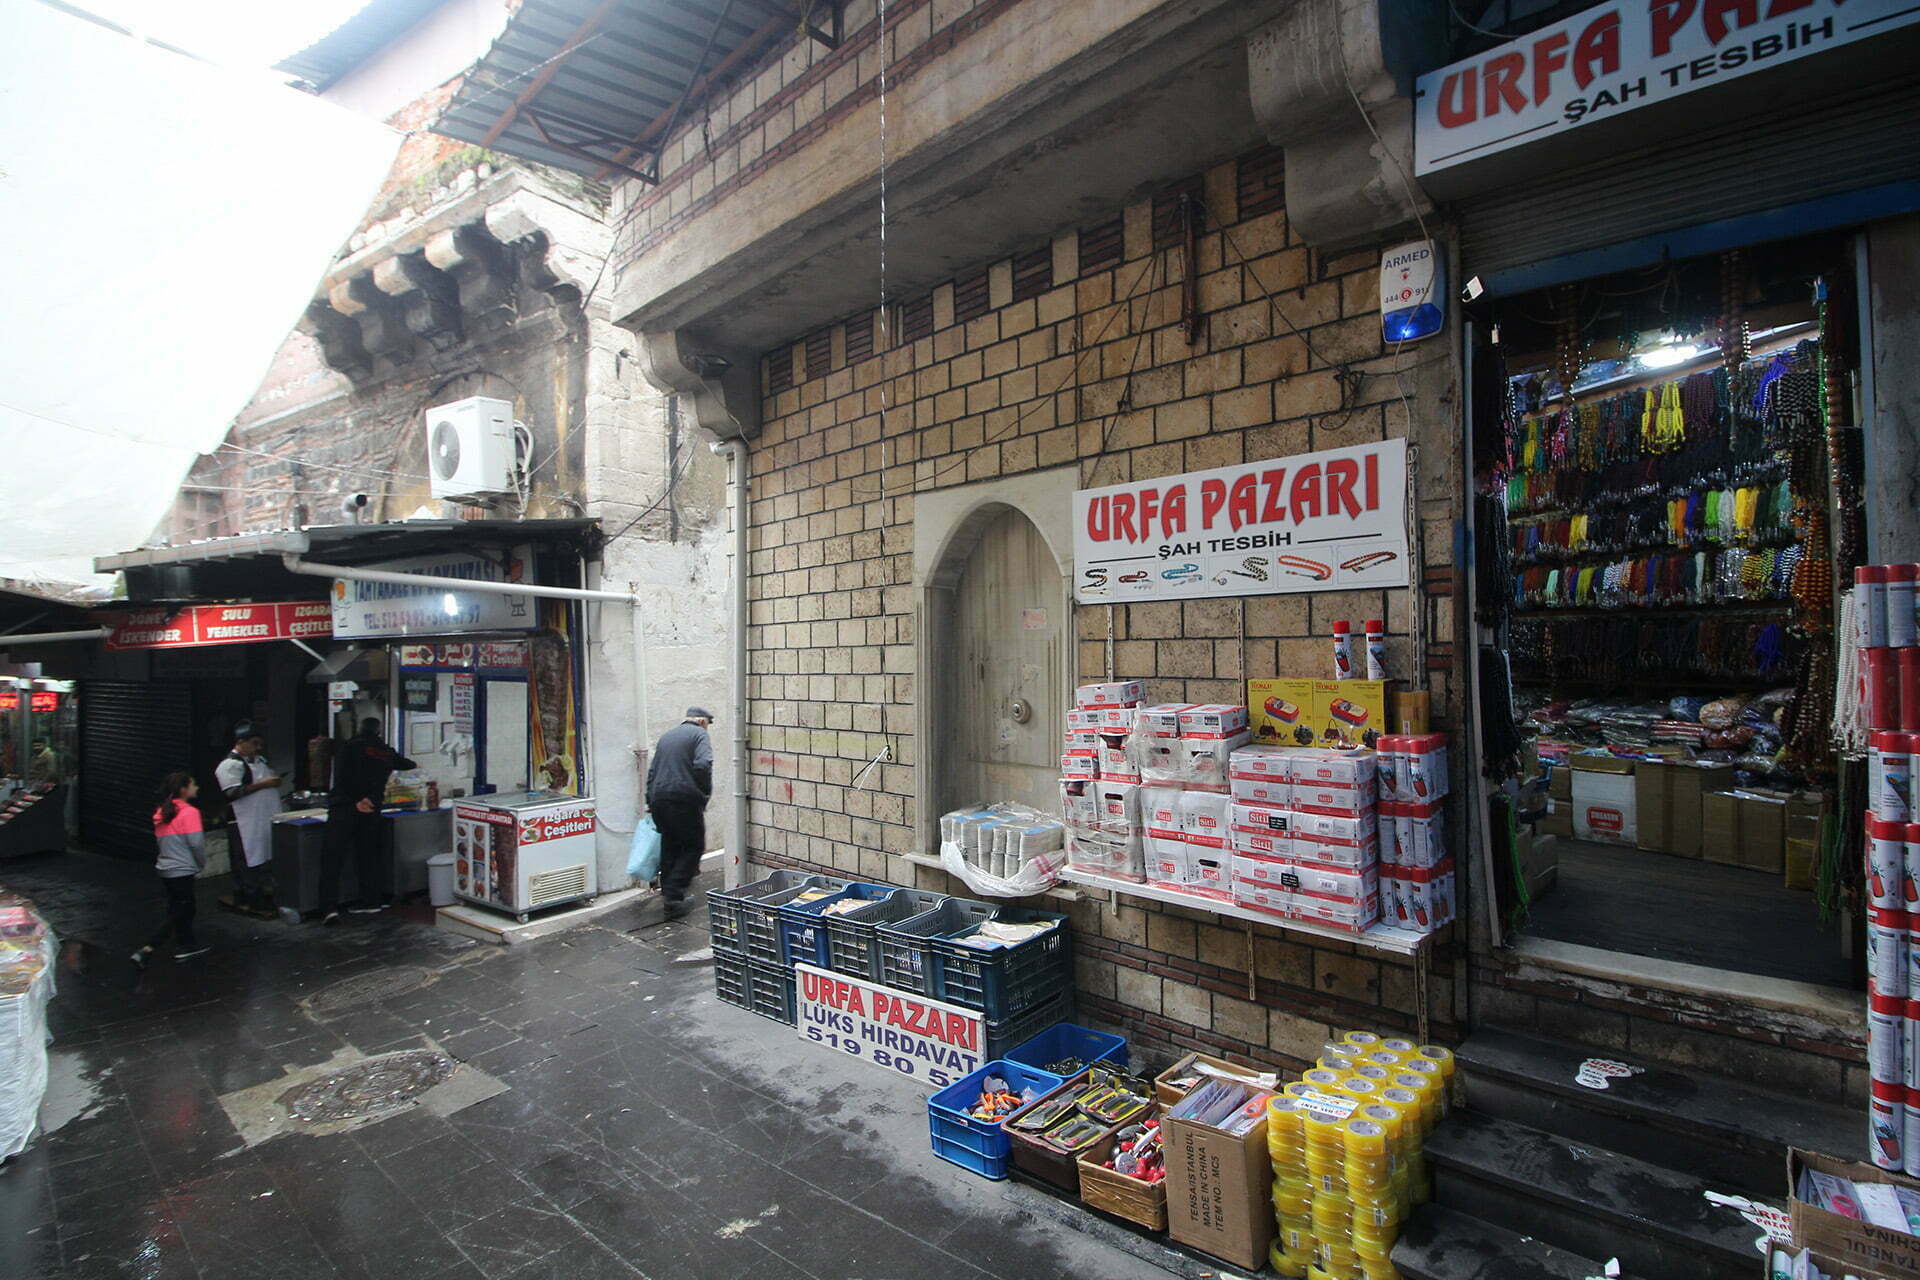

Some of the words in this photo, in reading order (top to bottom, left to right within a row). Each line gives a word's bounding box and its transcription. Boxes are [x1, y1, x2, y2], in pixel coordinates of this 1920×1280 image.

[1437, 10, 1623, 128] URFA
[1563, 77, 1647, 122] ŞAH
[1661, 17, 1834, 87] TESBİH
[1384, 249, 1430, 270] ARMED
[1087, 484, 1187, 544] URFA
[1201, 454, 1380, 532] PAZARI
[1158, 541, 1200, 560] ŞAH
[1207, 531, 1292, 552] TESBİH
[222, 609, 252, 621] SULU
[119, 628, 181, 643] İSKENDER
[206, 624, 269, 639] YEMEKLER
[544, 818, 592, 839] Çeşitleri
[802, 973, 866, 1017] URFA
[873, 991, 978, 1052] PAZARI
[803, 1002, 854, 1034] LÜKS
[861, 1021, 978, 1074] HIRDAVAT
[807, 1026, 861, 1055] 519
[873, 1050, 915, 1075] 80
[928, 1068, 961, 1088] 5
[1199, 1146, 1208, 1180] CHINA
[1201, 1182, 1209, 1194] IN
[1202, 1196, 1211, 1228] MADE
[1214, 1206, 1224, 1232] ITEM
